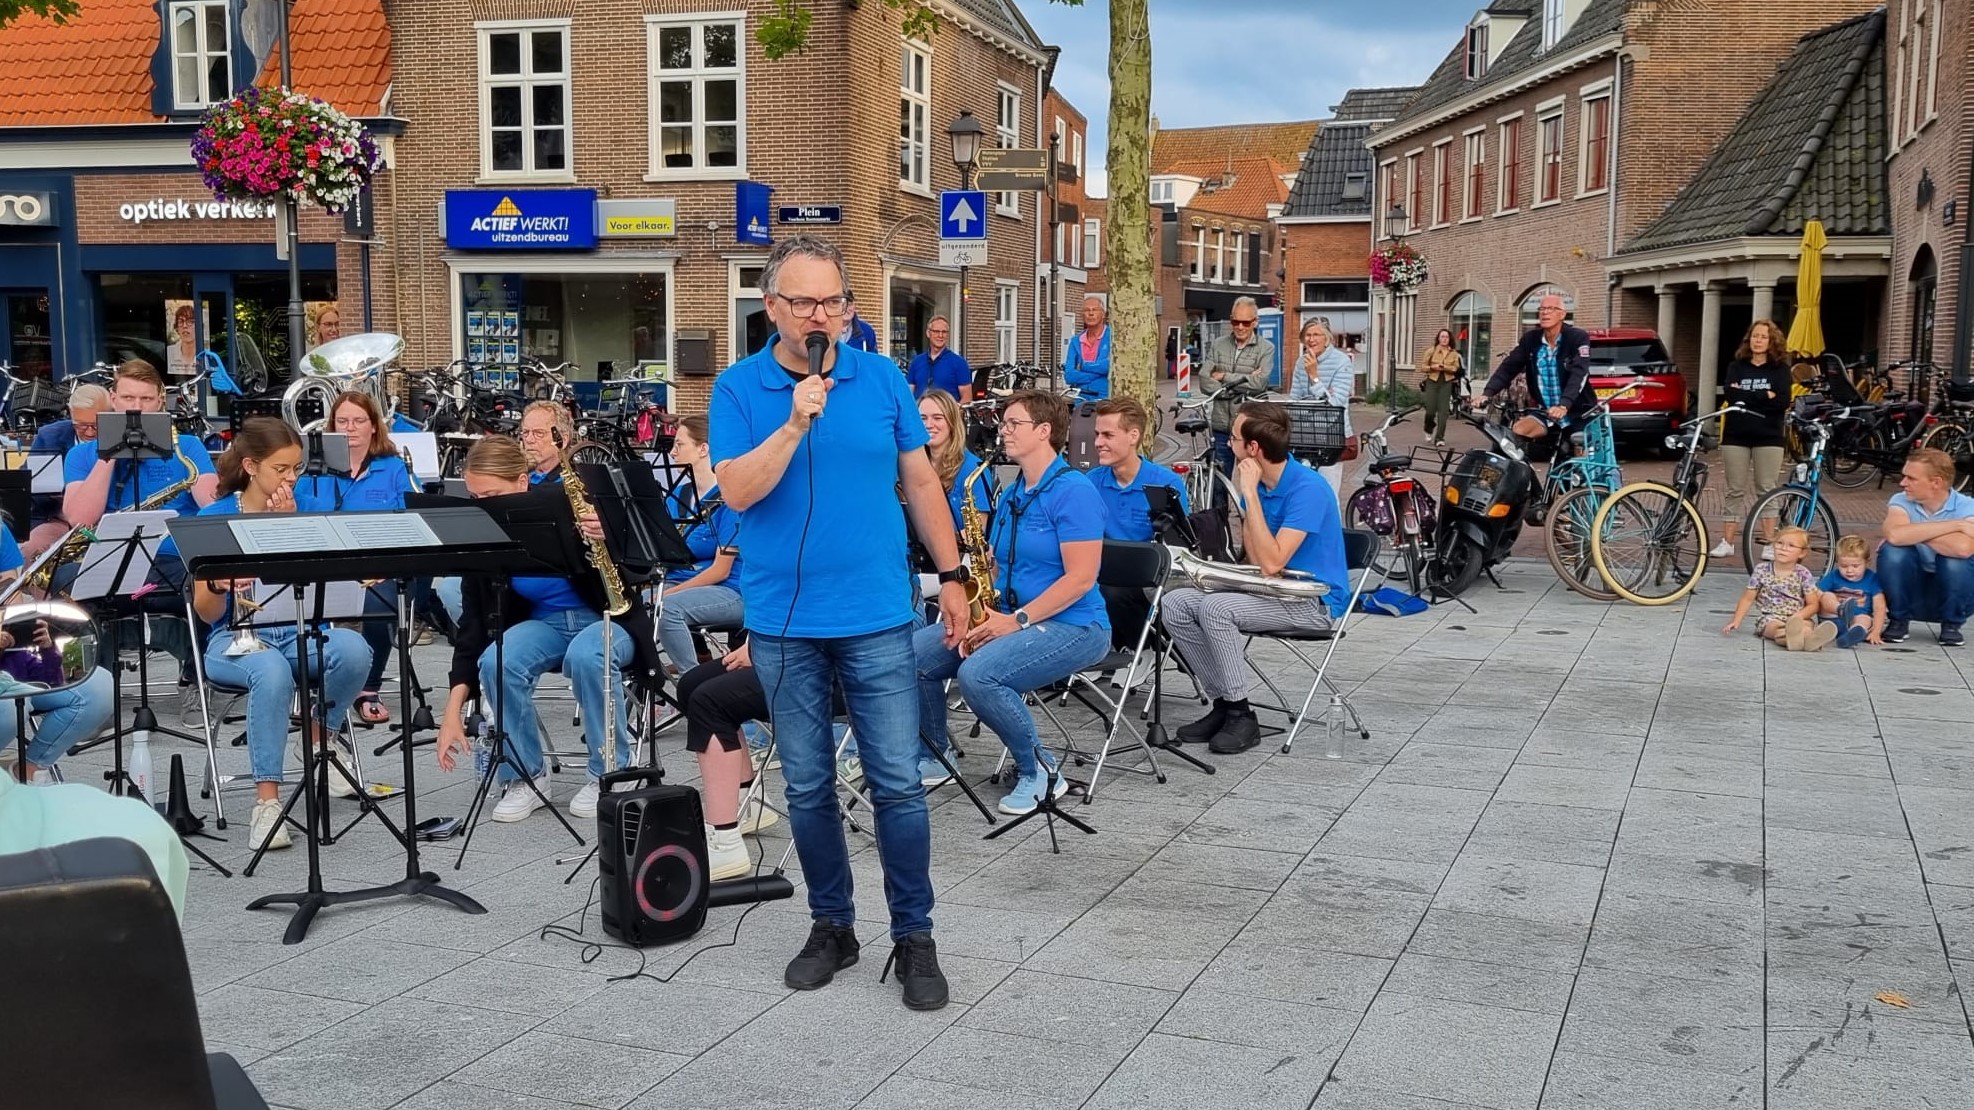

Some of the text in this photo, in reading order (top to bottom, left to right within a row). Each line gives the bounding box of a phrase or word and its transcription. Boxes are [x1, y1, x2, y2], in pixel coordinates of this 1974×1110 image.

[119, 198, 191, 223] optiek
[798, 207, 821, 217] Plein
[470, 217, 569, 231] ACTIEF WERKT!
[609, 220, 670, 230] Voor elkaar.
[491, 231, 569, 242] uitzendbureau
[941, 242, 985, 250] uitgezonderd
